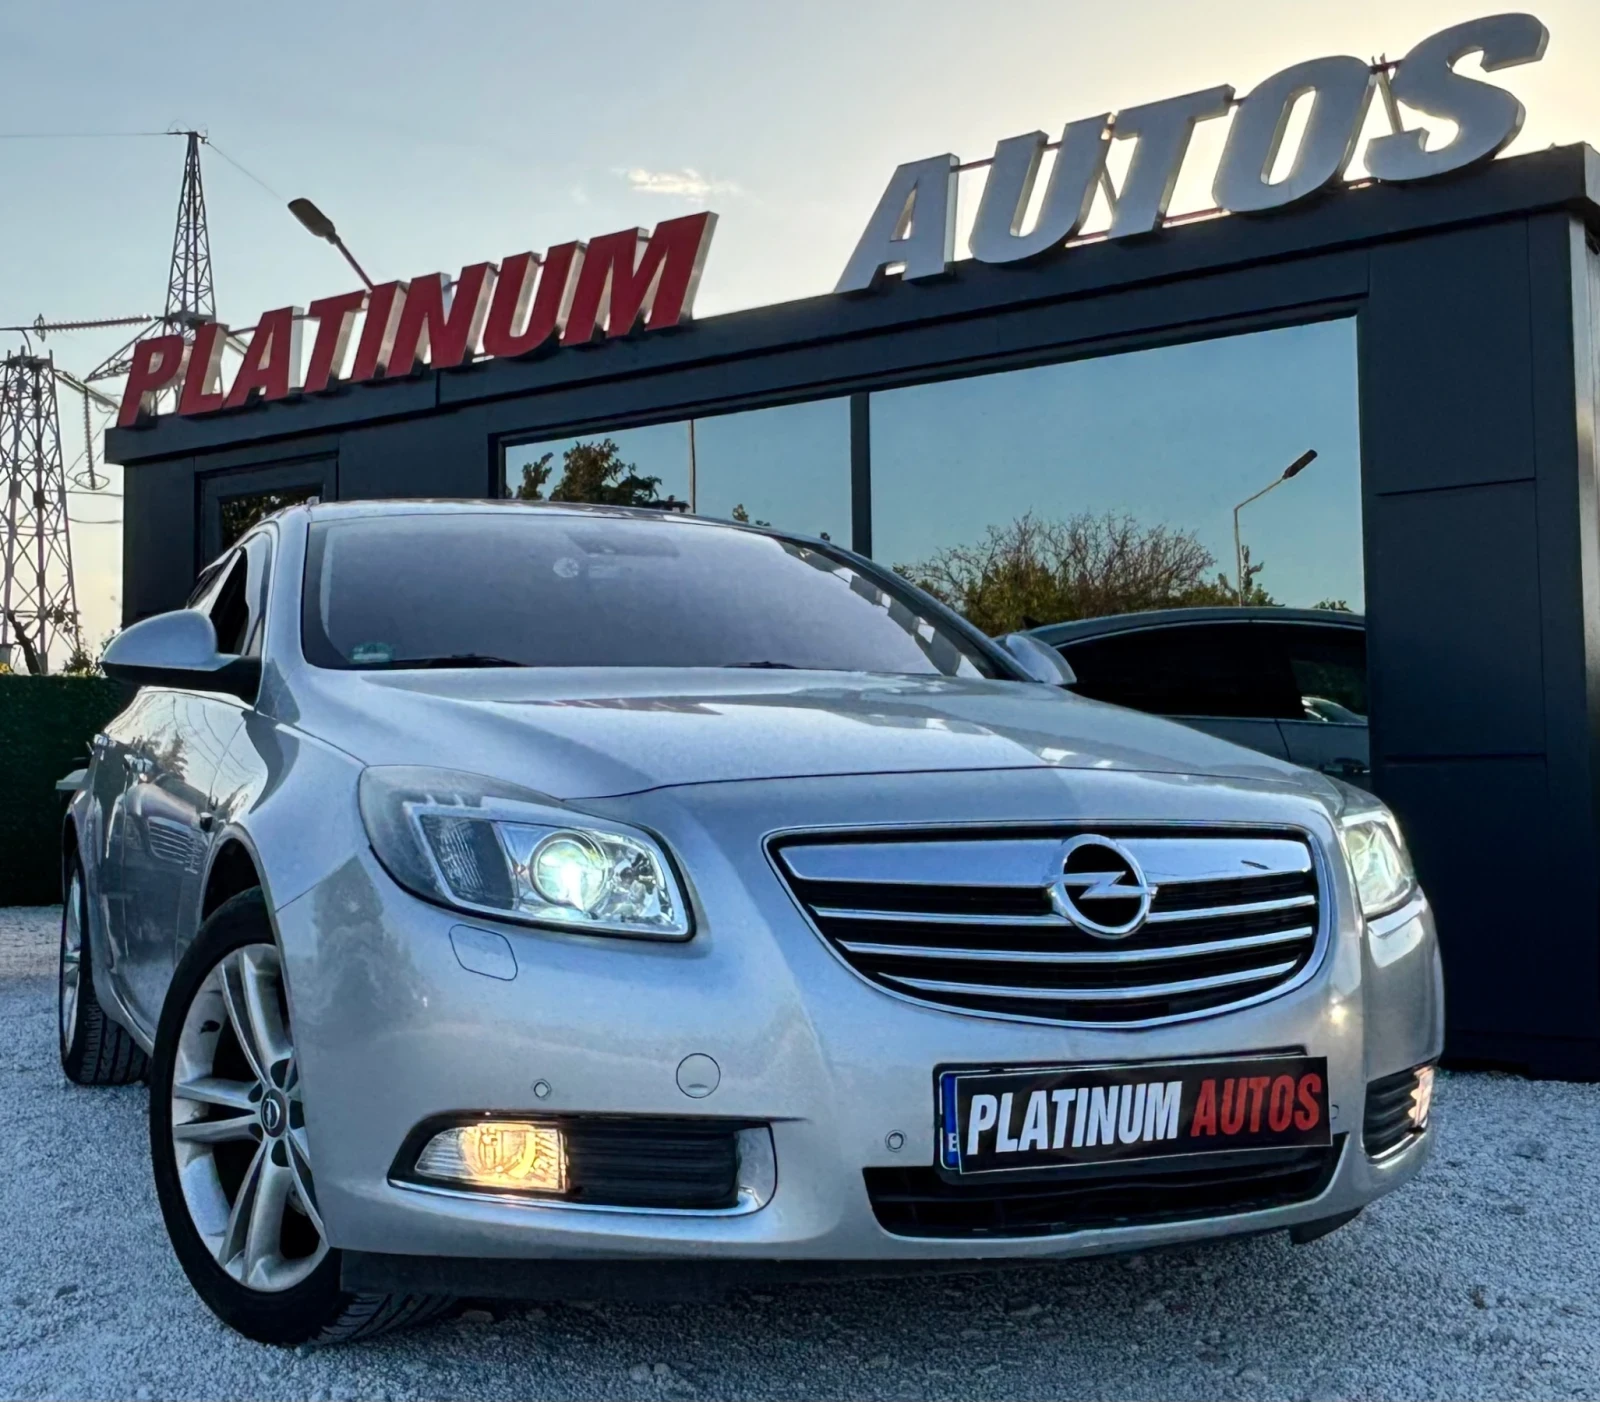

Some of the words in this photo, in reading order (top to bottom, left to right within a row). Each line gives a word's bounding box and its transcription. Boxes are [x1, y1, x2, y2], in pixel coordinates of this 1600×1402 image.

[119, 212, 718, 427] PLATINUM
[834, 12, 1549, 293] AUTOS
[966, 1081, 1183, 1155] PLATINUM
[1190, 1073, 1322, 1137] AUTOS
